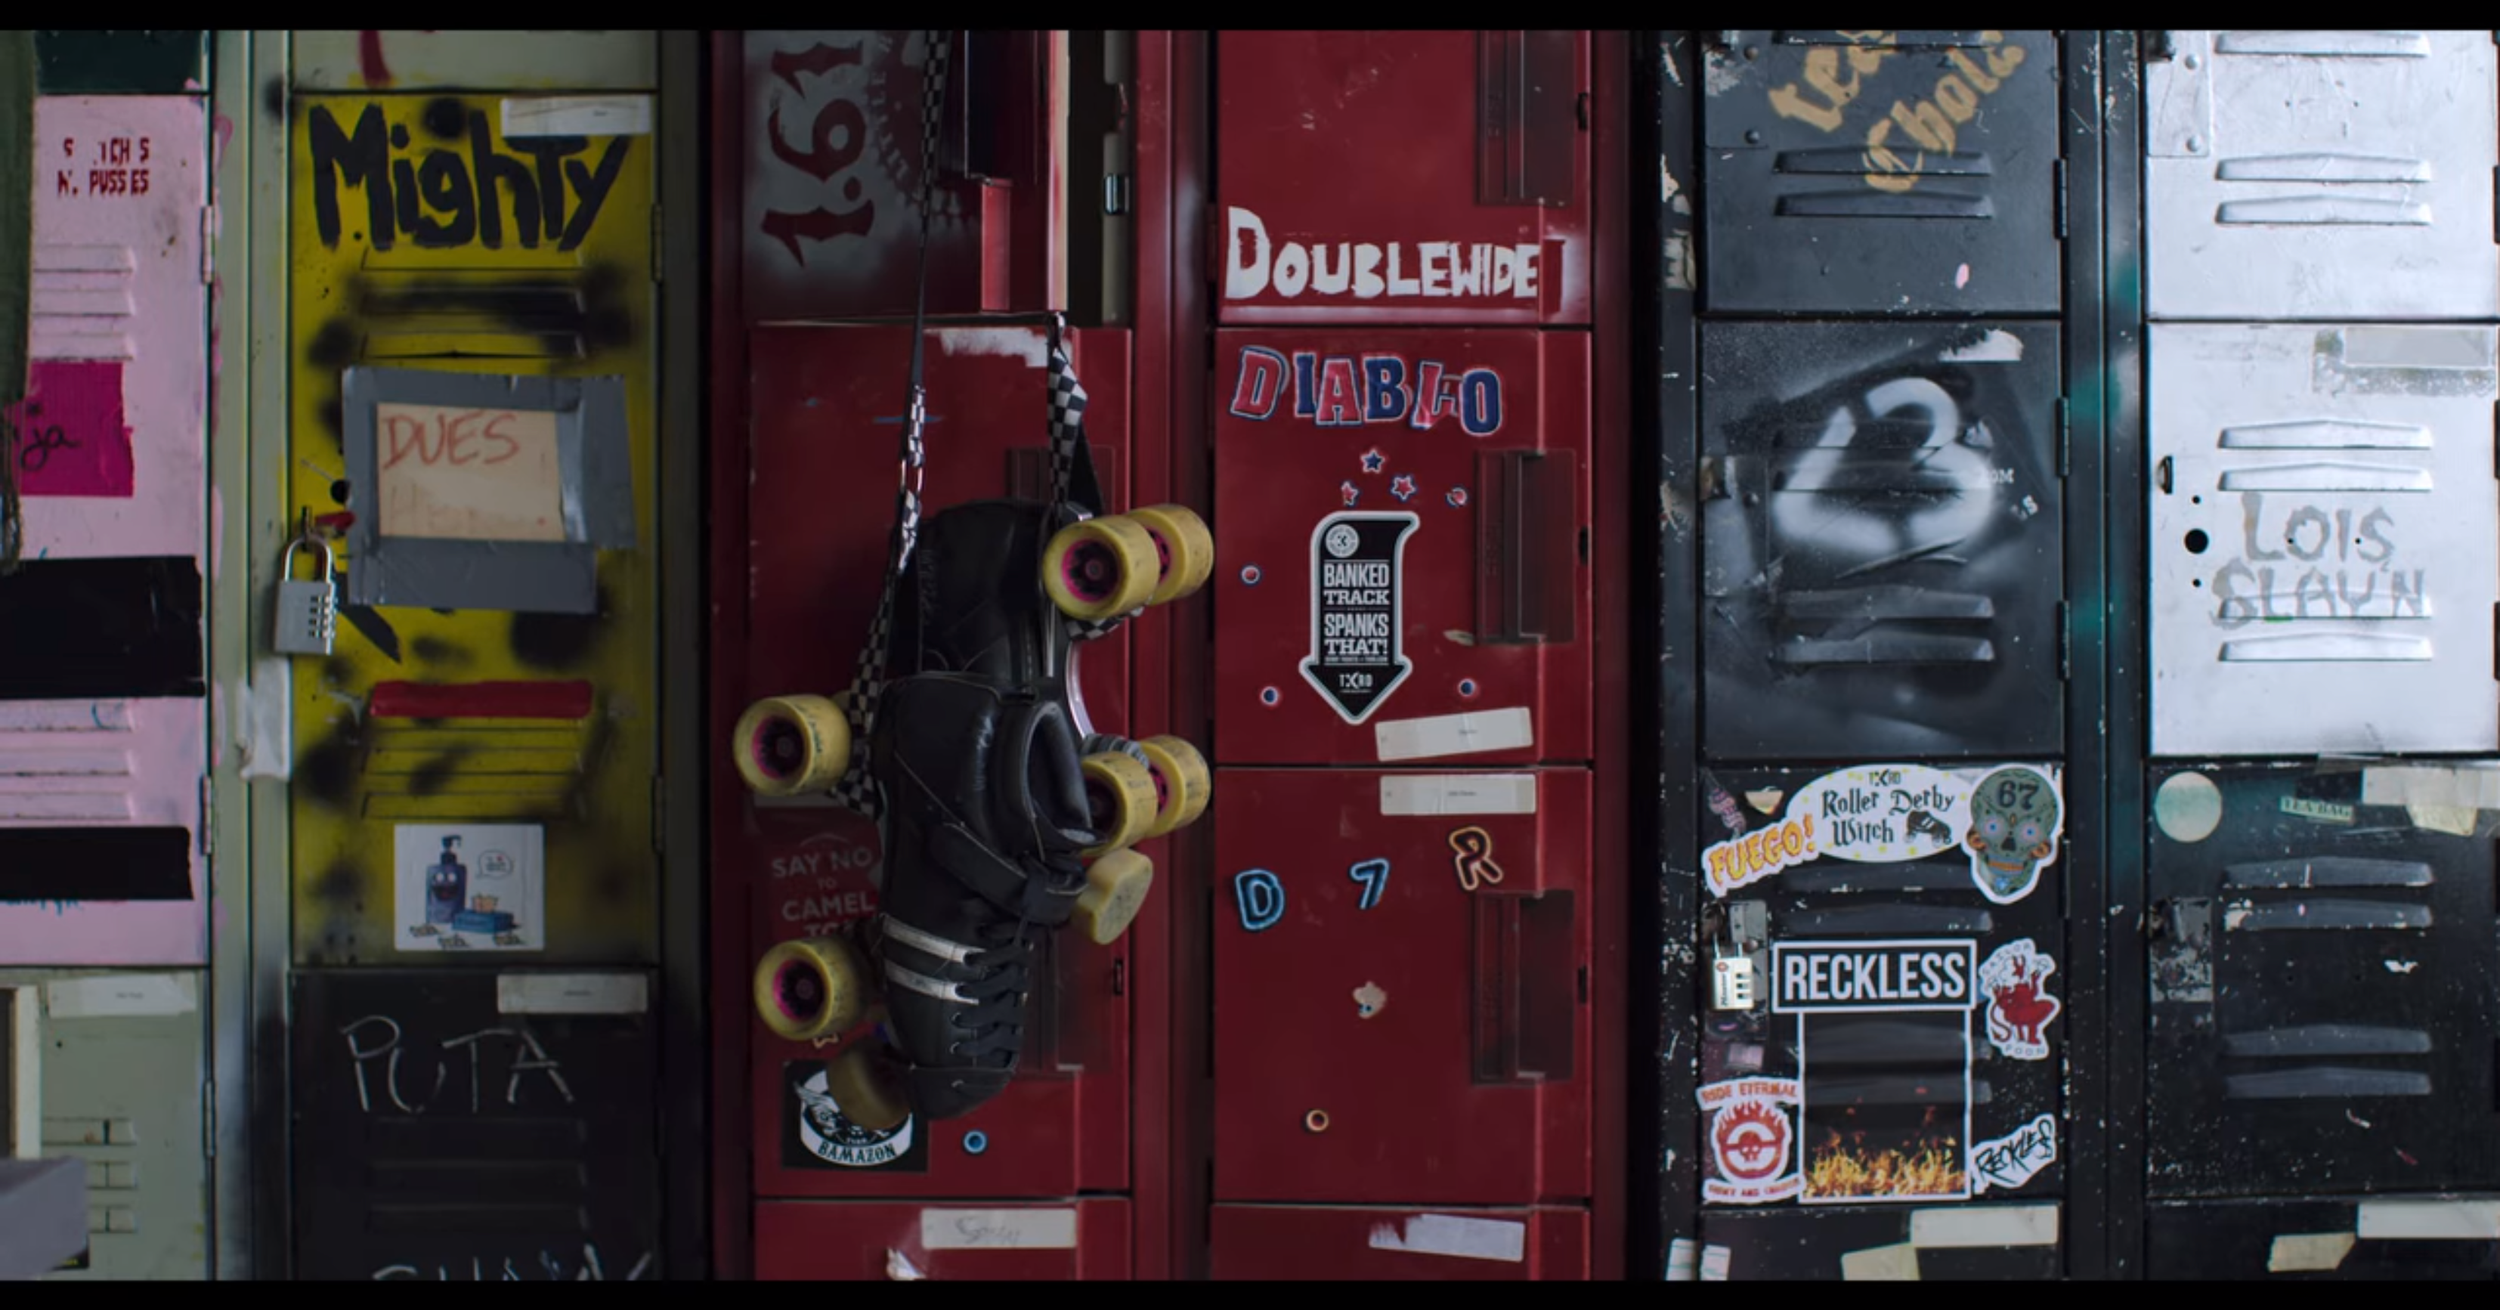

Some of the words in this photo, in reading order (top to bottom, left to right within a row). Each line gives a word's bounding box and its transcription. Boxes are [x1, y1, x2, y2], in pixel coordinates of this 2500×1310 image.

[760, 40, 876, 268] 1.61
[88, 169, 150, 197] PUSSES
[1230, 345, 1503, 437] DIABLO
[383, 410, 520, 470] DUES
[2240, 491, 2395, 562] LOIS
[1323, 563, 1390, 588] BANKED
[1323, 589, 1391, 606] TRACK
[1323, 612, 1389, 637] SPANKS
[1324, 638, 1388, 655] THAT!
[1822, 787, 1880, 818] Roller
[1889, 784, 1955, 816] Derby
[1997, 780, 2040, 811] 67
[1832, 818, 1894, 847] Witch
[771, 852, 820, 879] SAY
[830, 846, 873, 871] NO
[1448, 825, 1504, 890] R
[1709, 813, 1814, 887] FUEGO!
[817, 877, 838, 890] TO
[1235, 869, 1285, 930] D
[1349, 857, 1390, 910] 7
[781, 891, 877, 922] CAMEL
[1785, 952, 1966, 1000] RECKLESS
[339, 1015, 575, 1113] PUTA
[817, 1139, 896, 1164] BAMAZON
